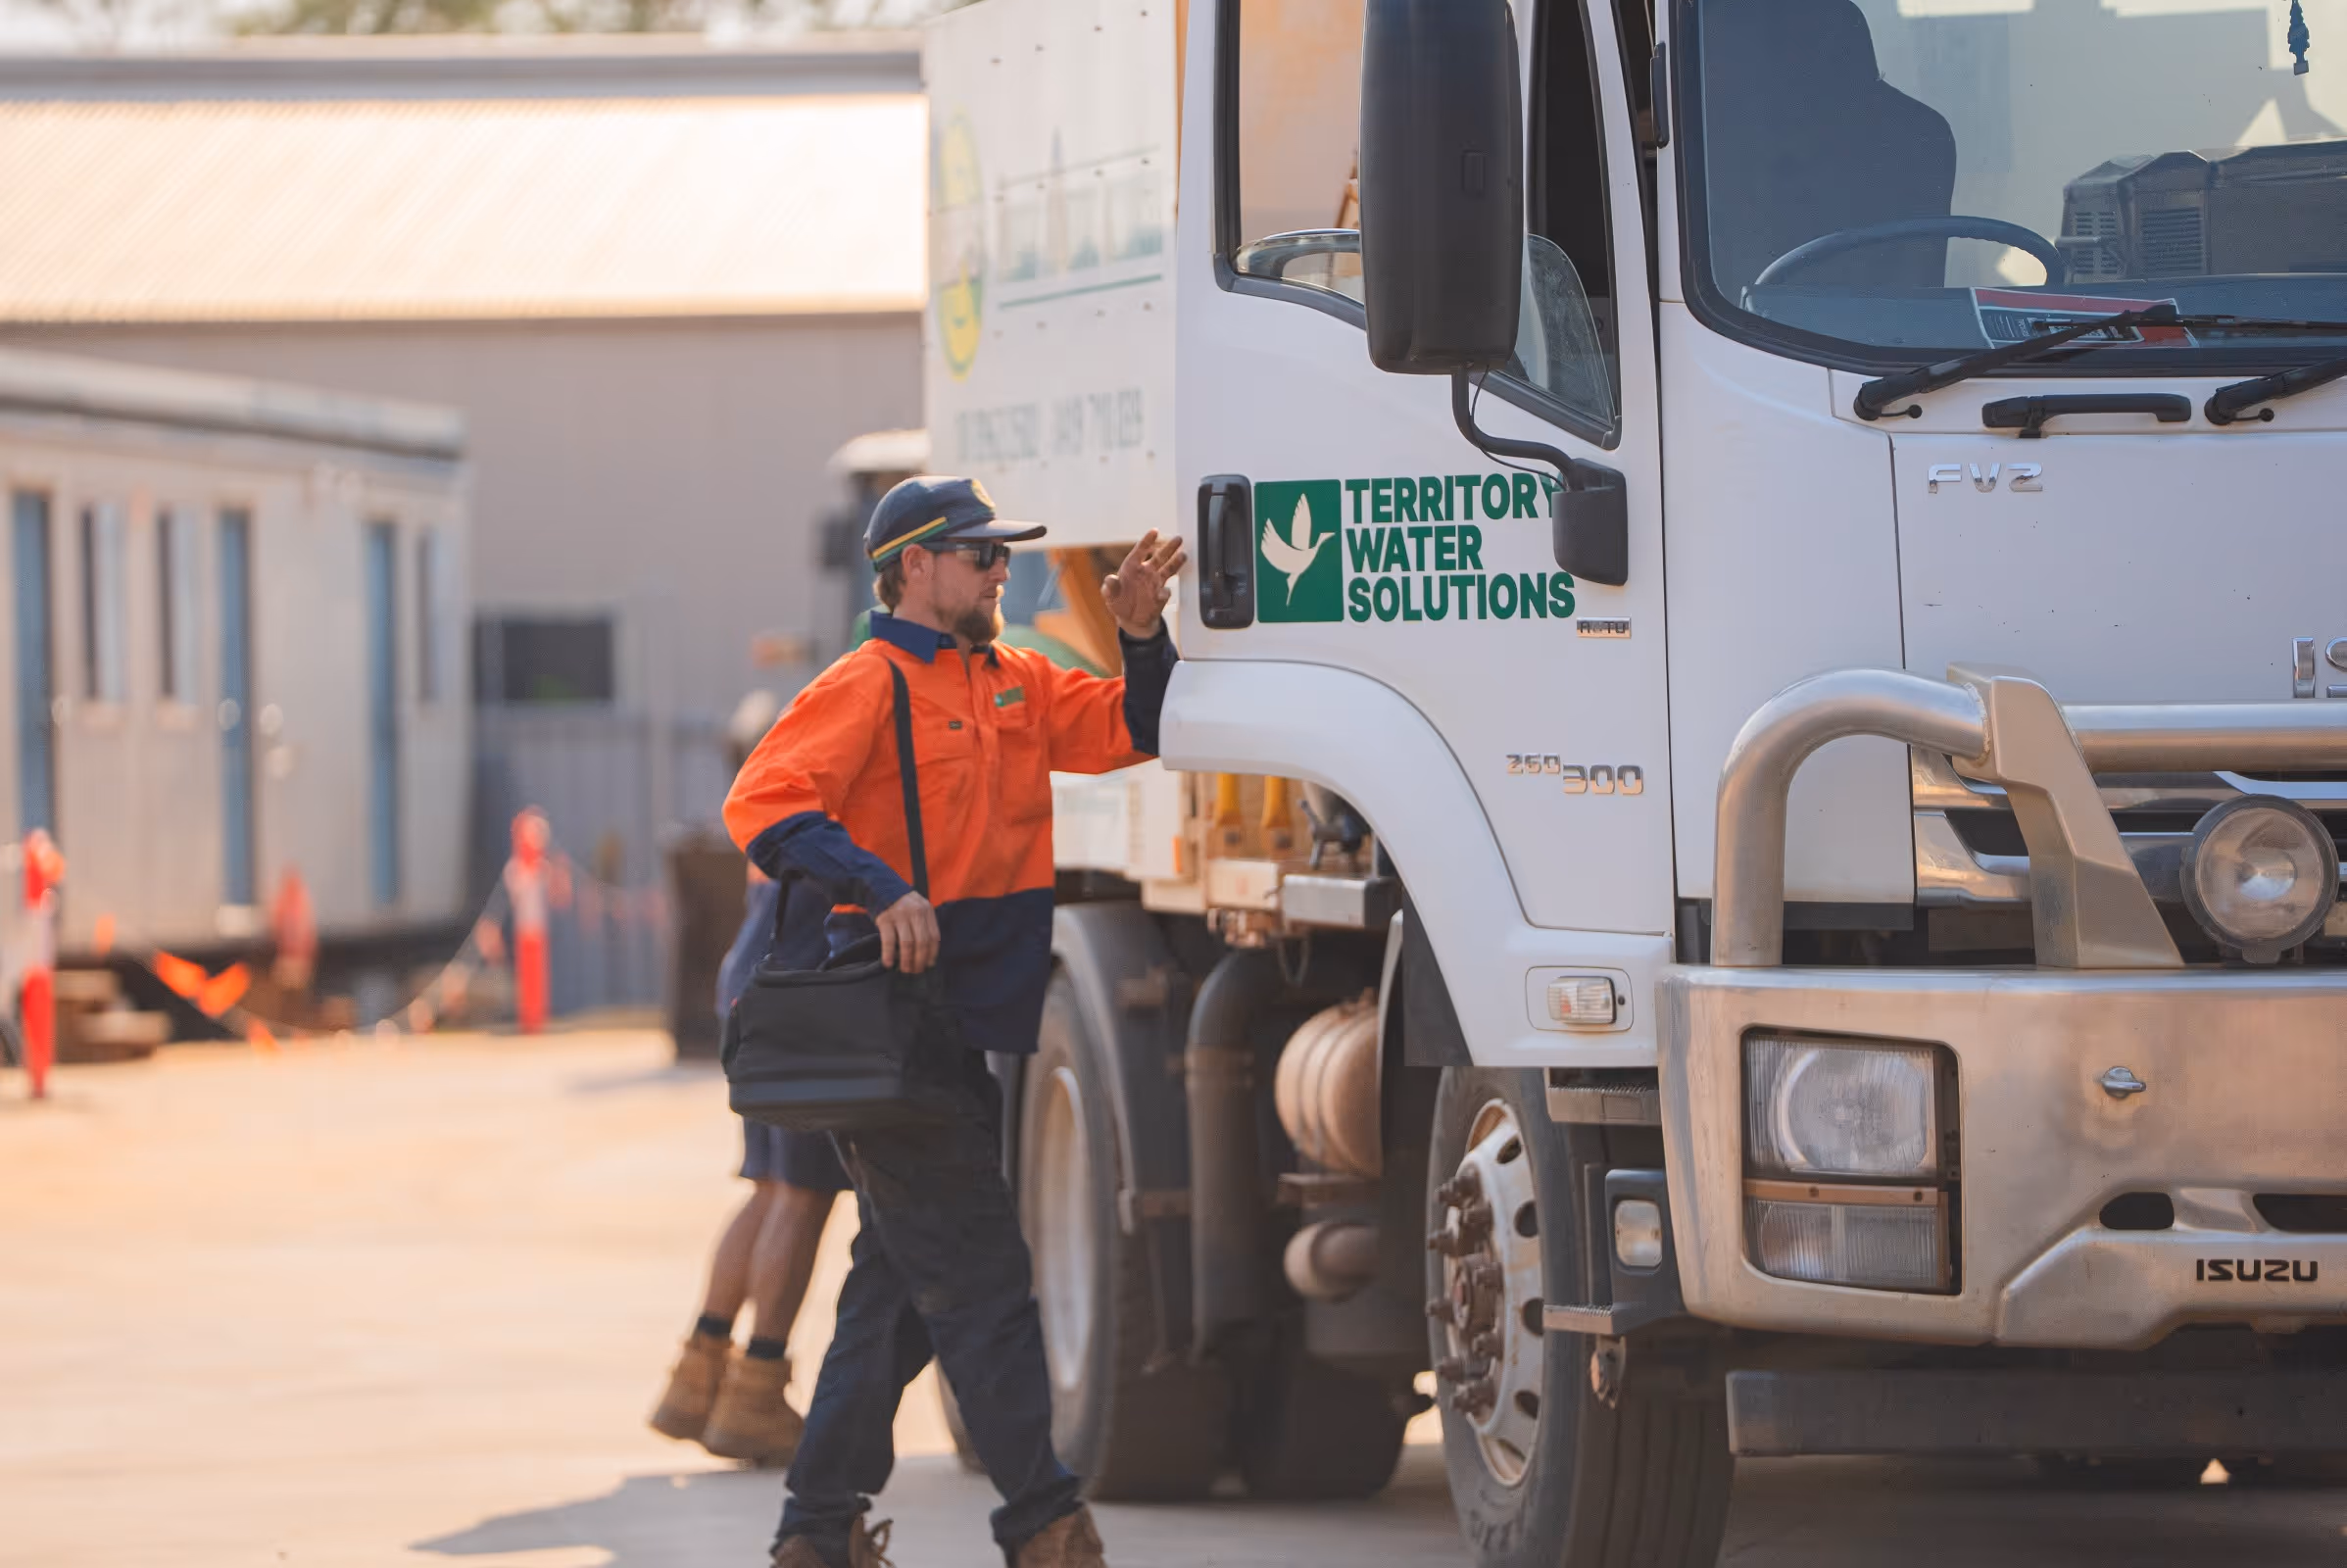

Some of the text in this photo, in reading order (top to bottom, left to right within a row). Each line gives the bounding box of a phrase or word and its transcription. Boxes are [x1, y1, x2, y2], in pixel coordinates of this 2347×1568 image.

[1345, 524, 1484, 573] WATER
[1347, 571, 1576, 622] SOLUTIONS
[1506, 753, 1643, 795] 260 300
[2196, 1258, 2319, 1282] ISUZU
